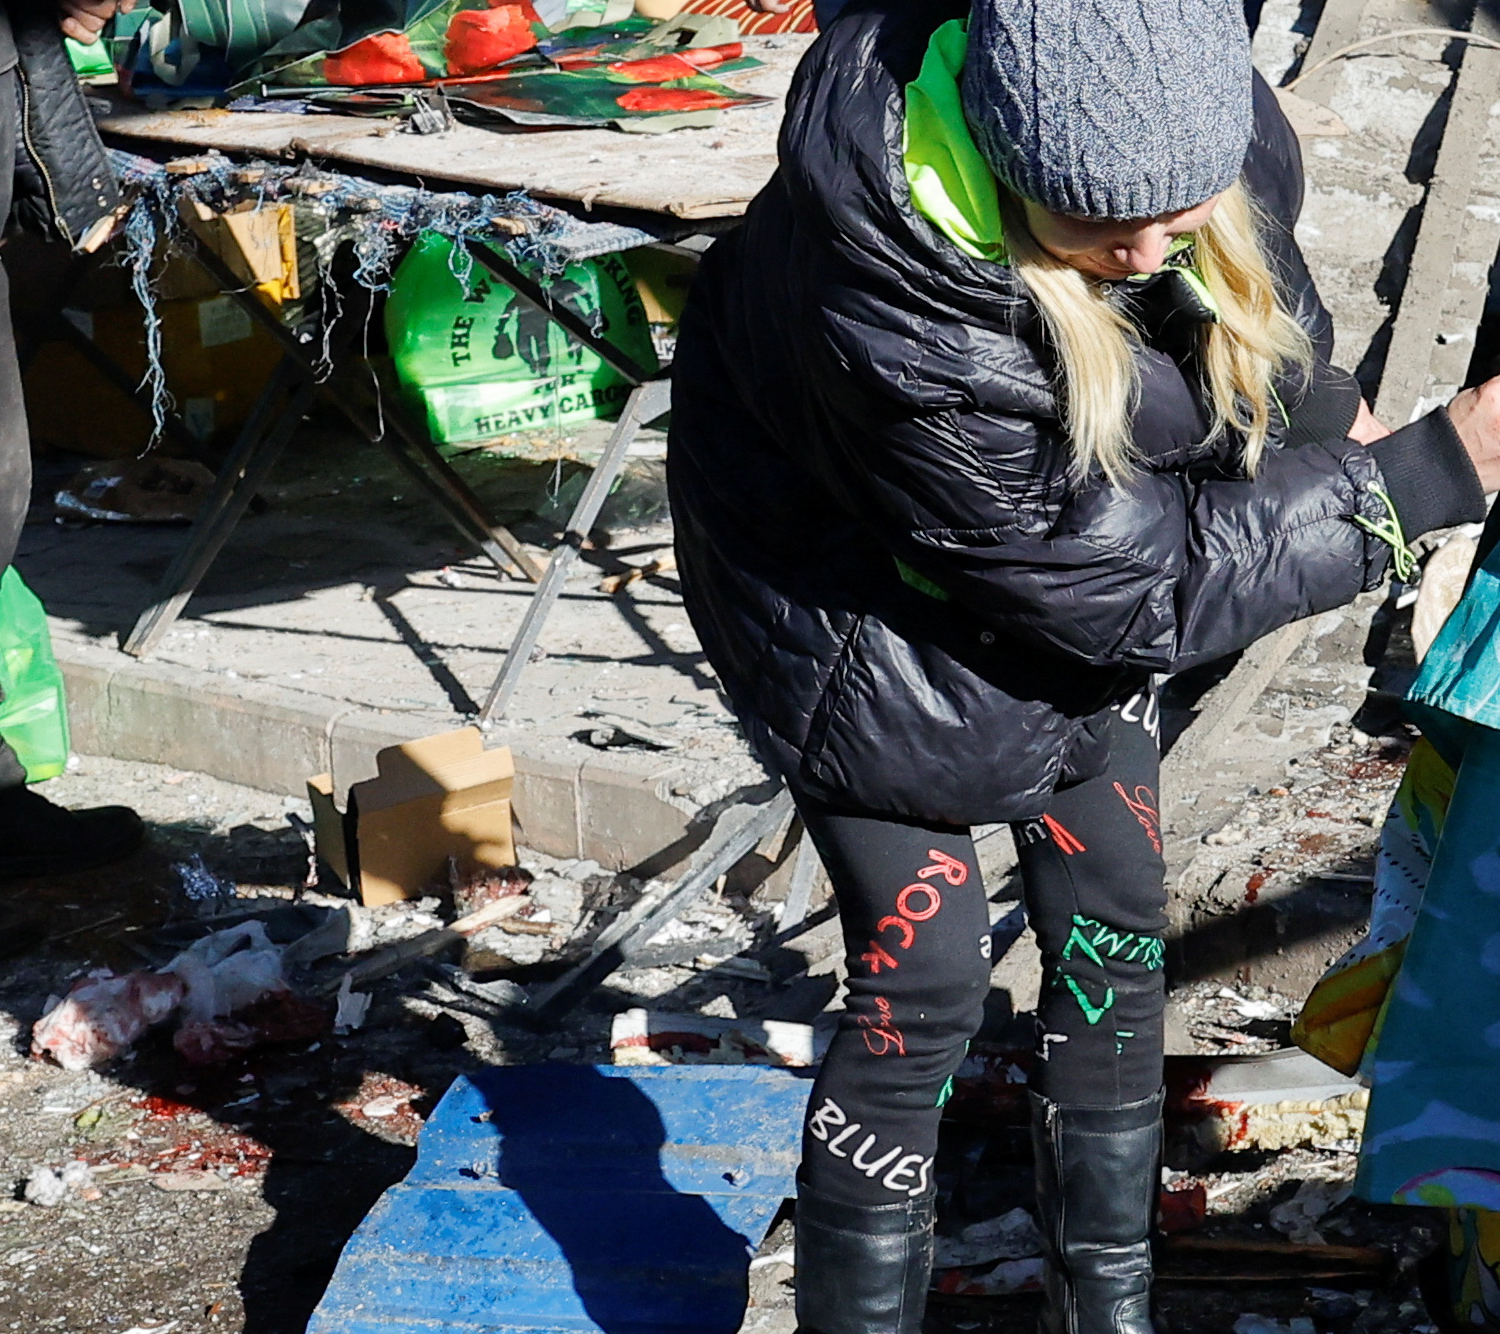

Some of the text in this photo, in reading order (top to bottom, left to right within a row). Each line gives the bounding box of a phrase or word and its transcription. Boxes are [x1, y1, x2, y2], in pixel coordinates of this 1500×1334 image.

[450, 316, 474, 367] THE
[474, 384, 632, 435] HEAVY CARG
[861, 848, 968, 974] ROCK
[809, 1097, 933, 1196] BLUES
